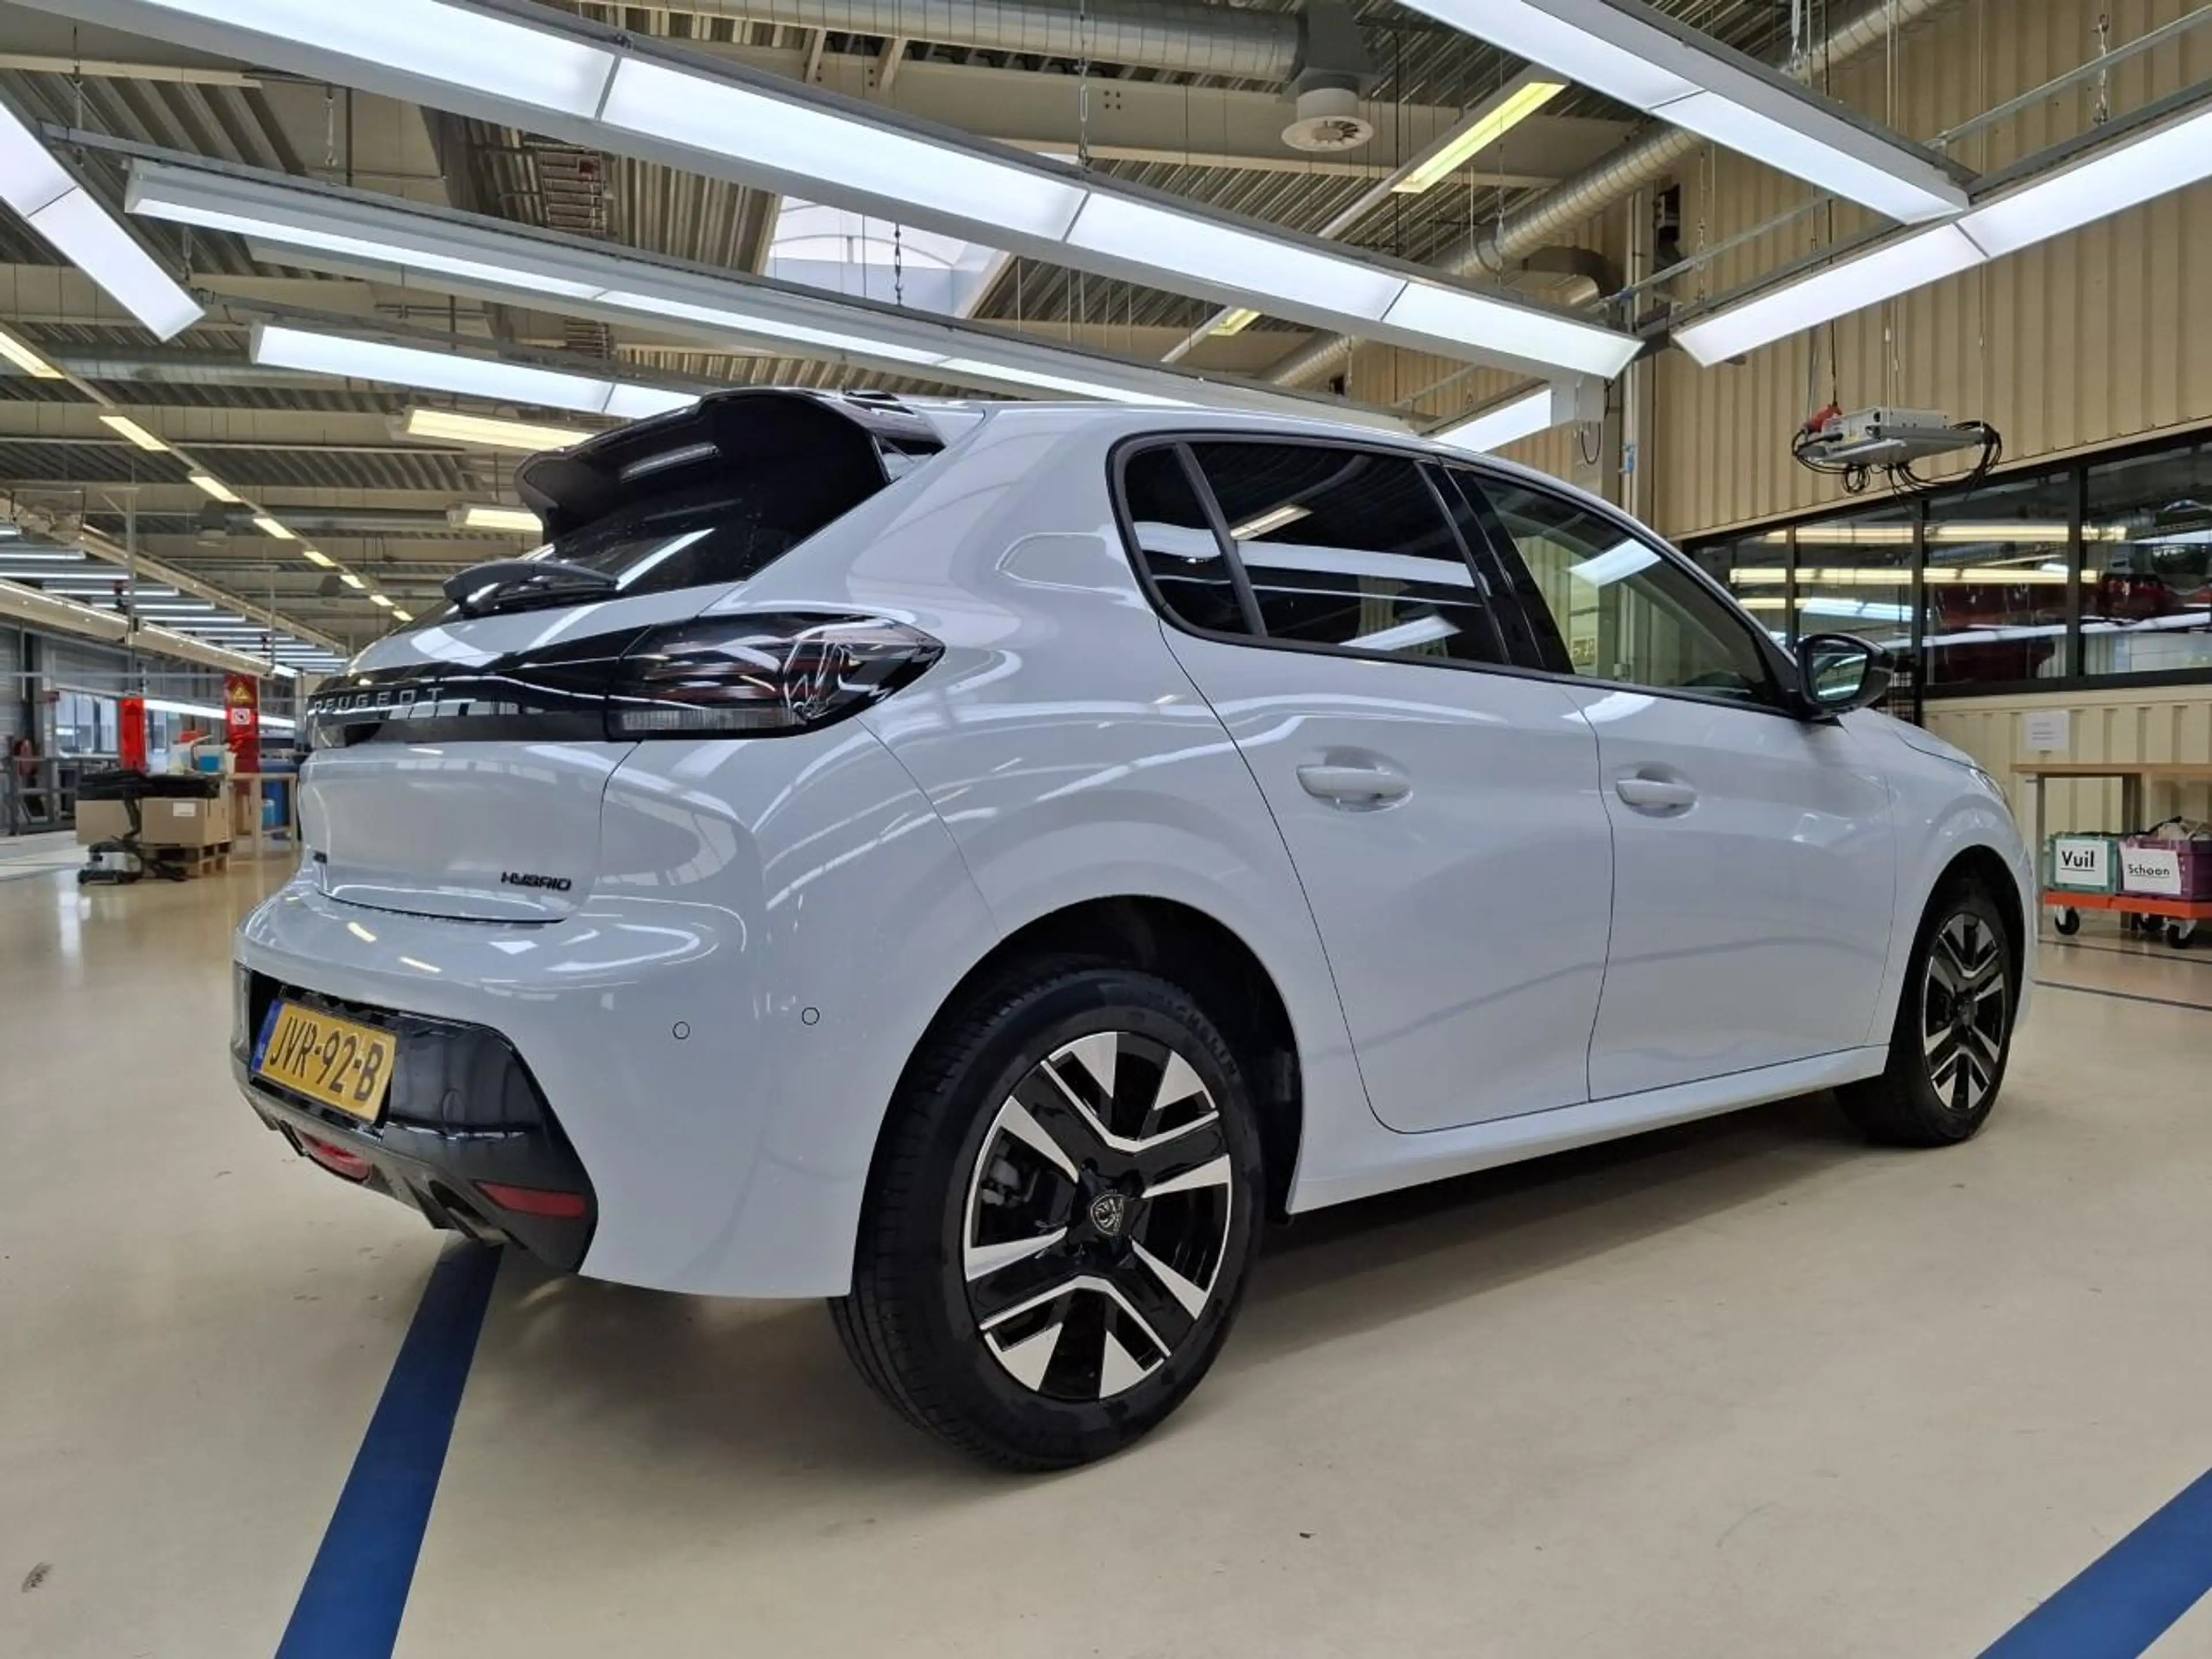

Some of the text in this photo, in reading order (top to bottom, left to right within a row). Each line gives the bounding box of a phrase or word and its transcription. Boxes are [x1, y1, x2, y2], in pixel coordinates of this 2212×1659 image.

[2061, 850, 2095, 868] Vuil
[2128, 863, 2171, 876] Schoon
[500, 871, 572, 892] HYBRID
[269, 1016, 384, 1101] JVR-92-B
